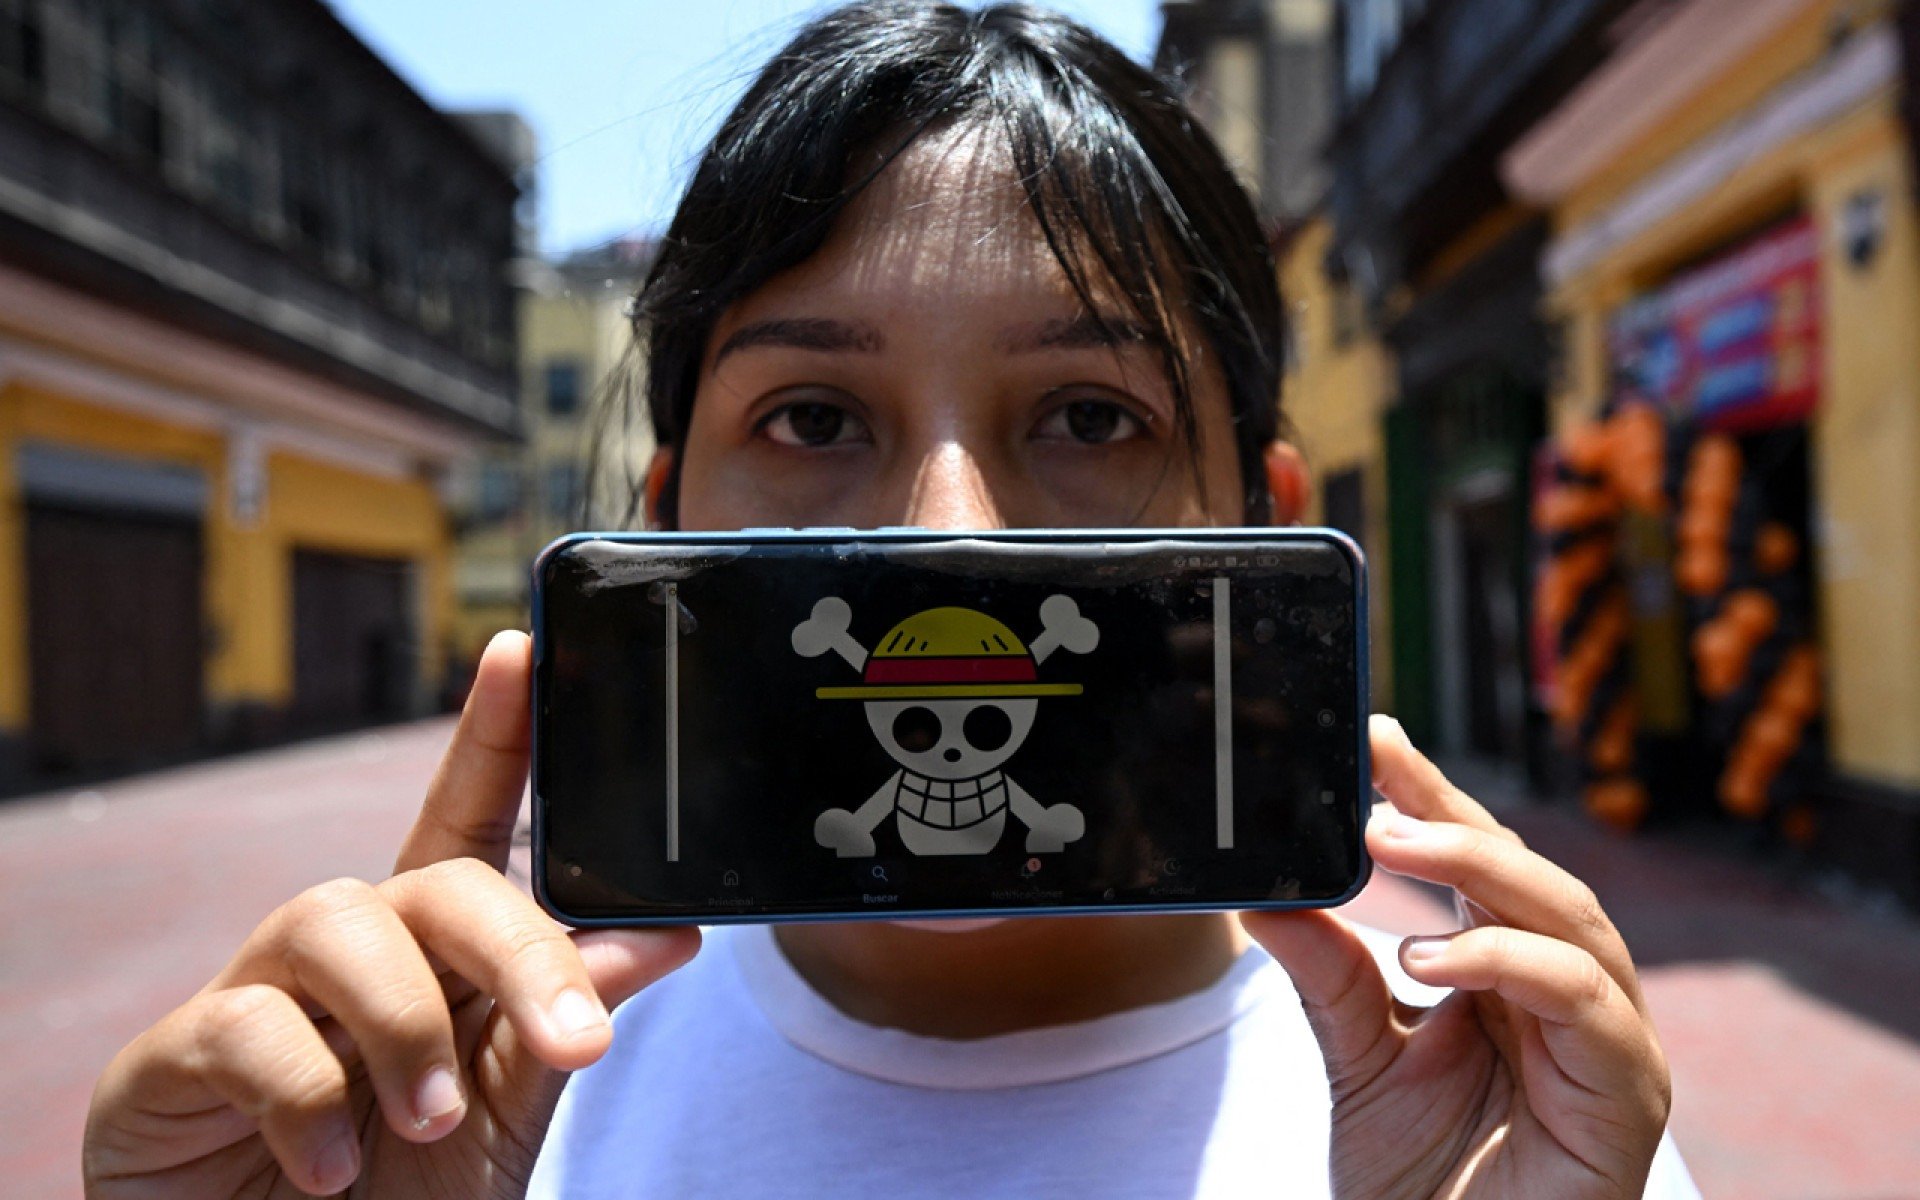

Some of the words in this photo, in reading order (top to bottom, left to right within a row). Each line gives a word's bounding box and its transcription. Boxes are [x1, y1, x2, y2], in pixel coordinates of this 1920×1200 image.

[863, 893, 898, 904] Buscar
[992, 888, 1064, 900] Notificaciones
[708, 896, 754, 908] Principal
